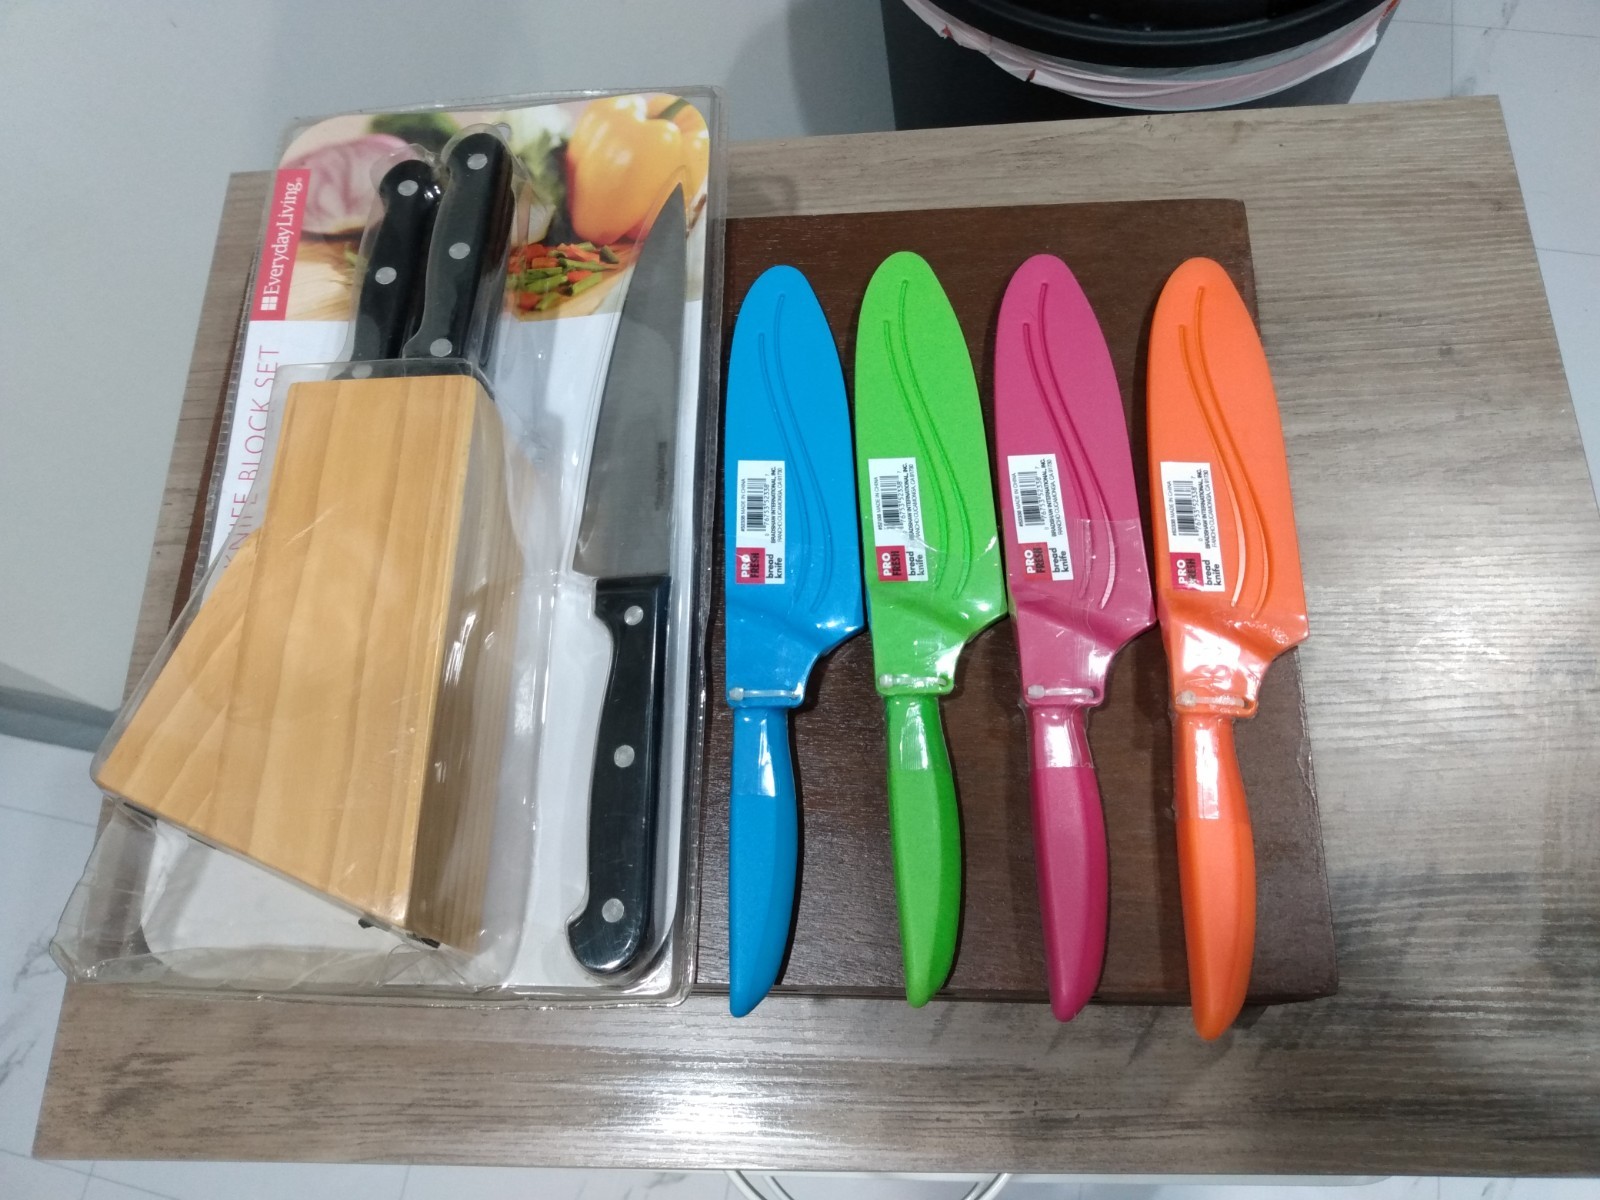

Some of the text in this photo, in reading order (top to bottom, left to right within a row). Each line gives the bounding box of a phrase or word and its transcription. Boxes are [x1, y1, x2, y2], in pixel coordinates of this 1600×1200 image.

[254, 344, 280, 388] SET
[741, 554, 750, 577] PRO
[750, 553, 759, 578] FRESH
[766, 554, 774, 578] bread
[882, 552, 892, 576] PRO
[891, 551, 901, 576] FRESH
[906, 551, 916, 576] bread
[916, 554, 924, 575] knife
[1024, 549, 1036, 574] PRO
[1034, 548, 1045, 573] FRESH
[1049, 548, 1060, 573] bread
[1059, 551, 1069, 572] knife
[1177, 559, 1187, 584] PRO
[1203, 560, 1212, 585] bread
[1212, 564, 1221, 586] knife
